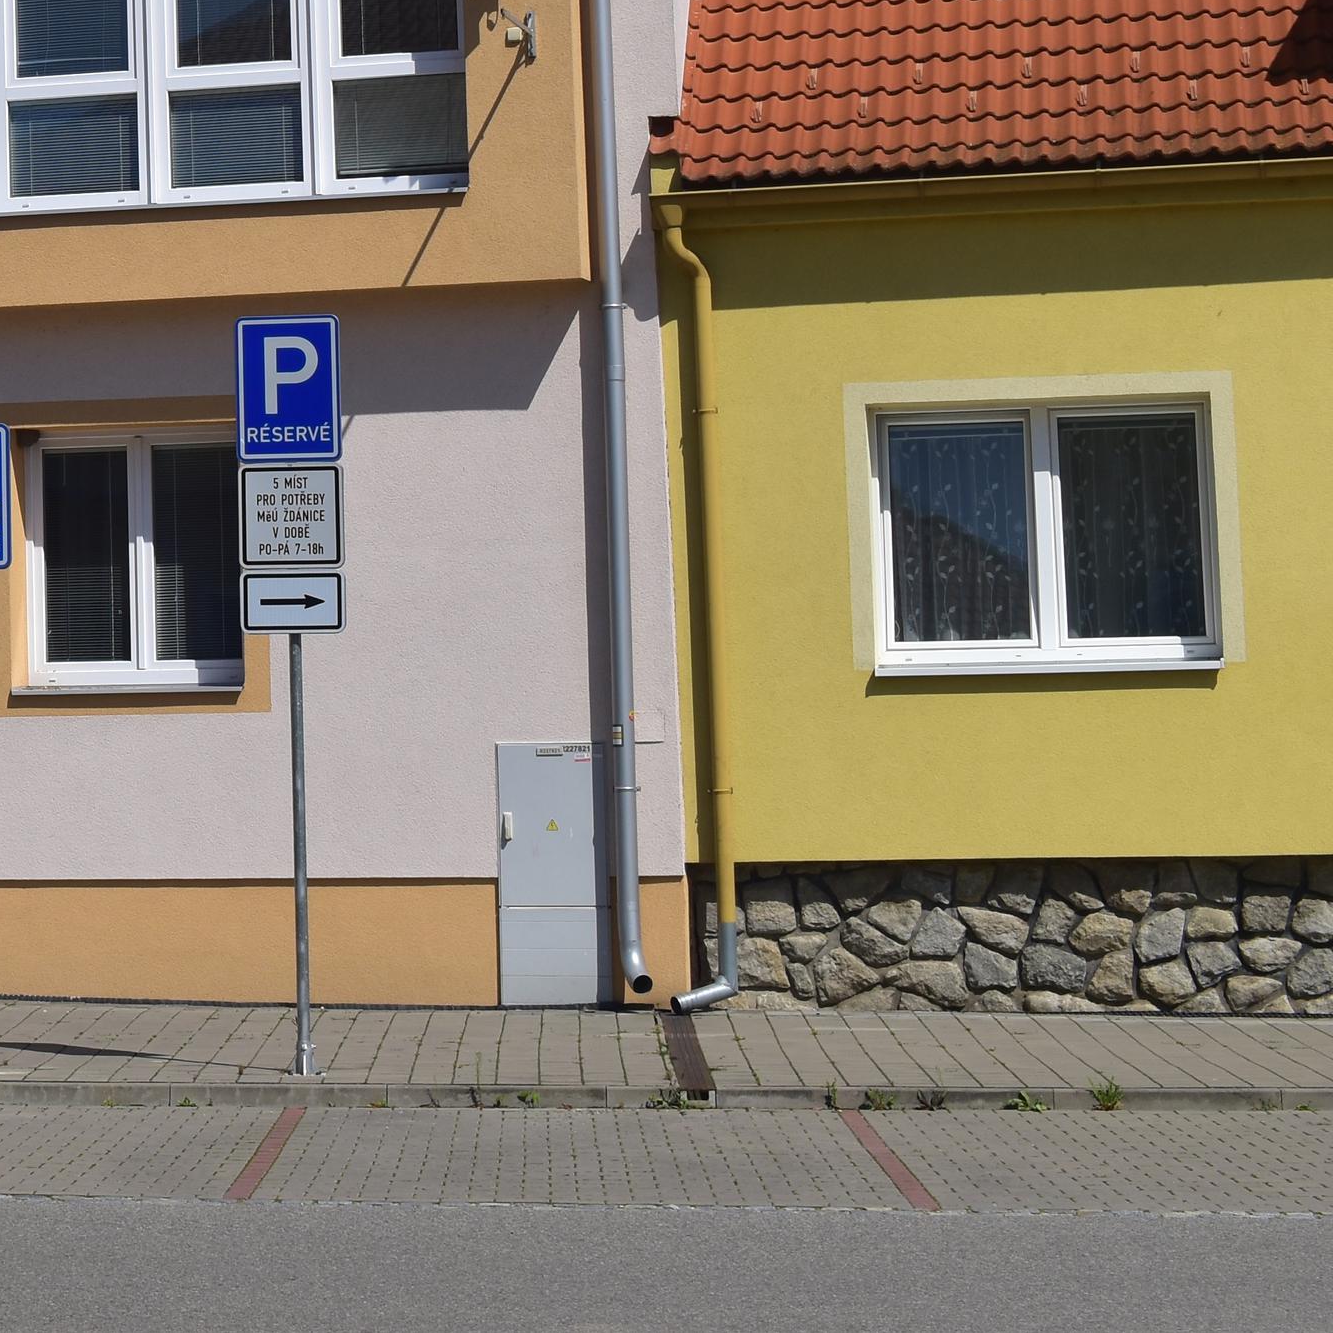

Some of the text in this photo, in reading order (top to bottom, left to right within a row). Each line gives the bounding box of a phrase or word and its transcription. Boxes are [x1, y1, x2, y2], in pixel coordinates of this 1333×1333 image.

[263, 336, 319, 415] P
[247, 421, 331, 443] RÉSERVÉ
[273, 474, 309, 489] 5 MÍST
[256, 491, 326, 506] PRO POTŘEBY
[257, 507, 326, 523] MěÚ ŽDÁNICE
[273, 523, 310, 539] V DOBĚ
[259, 540, 324, 555] PO-PÁ 7-18h
